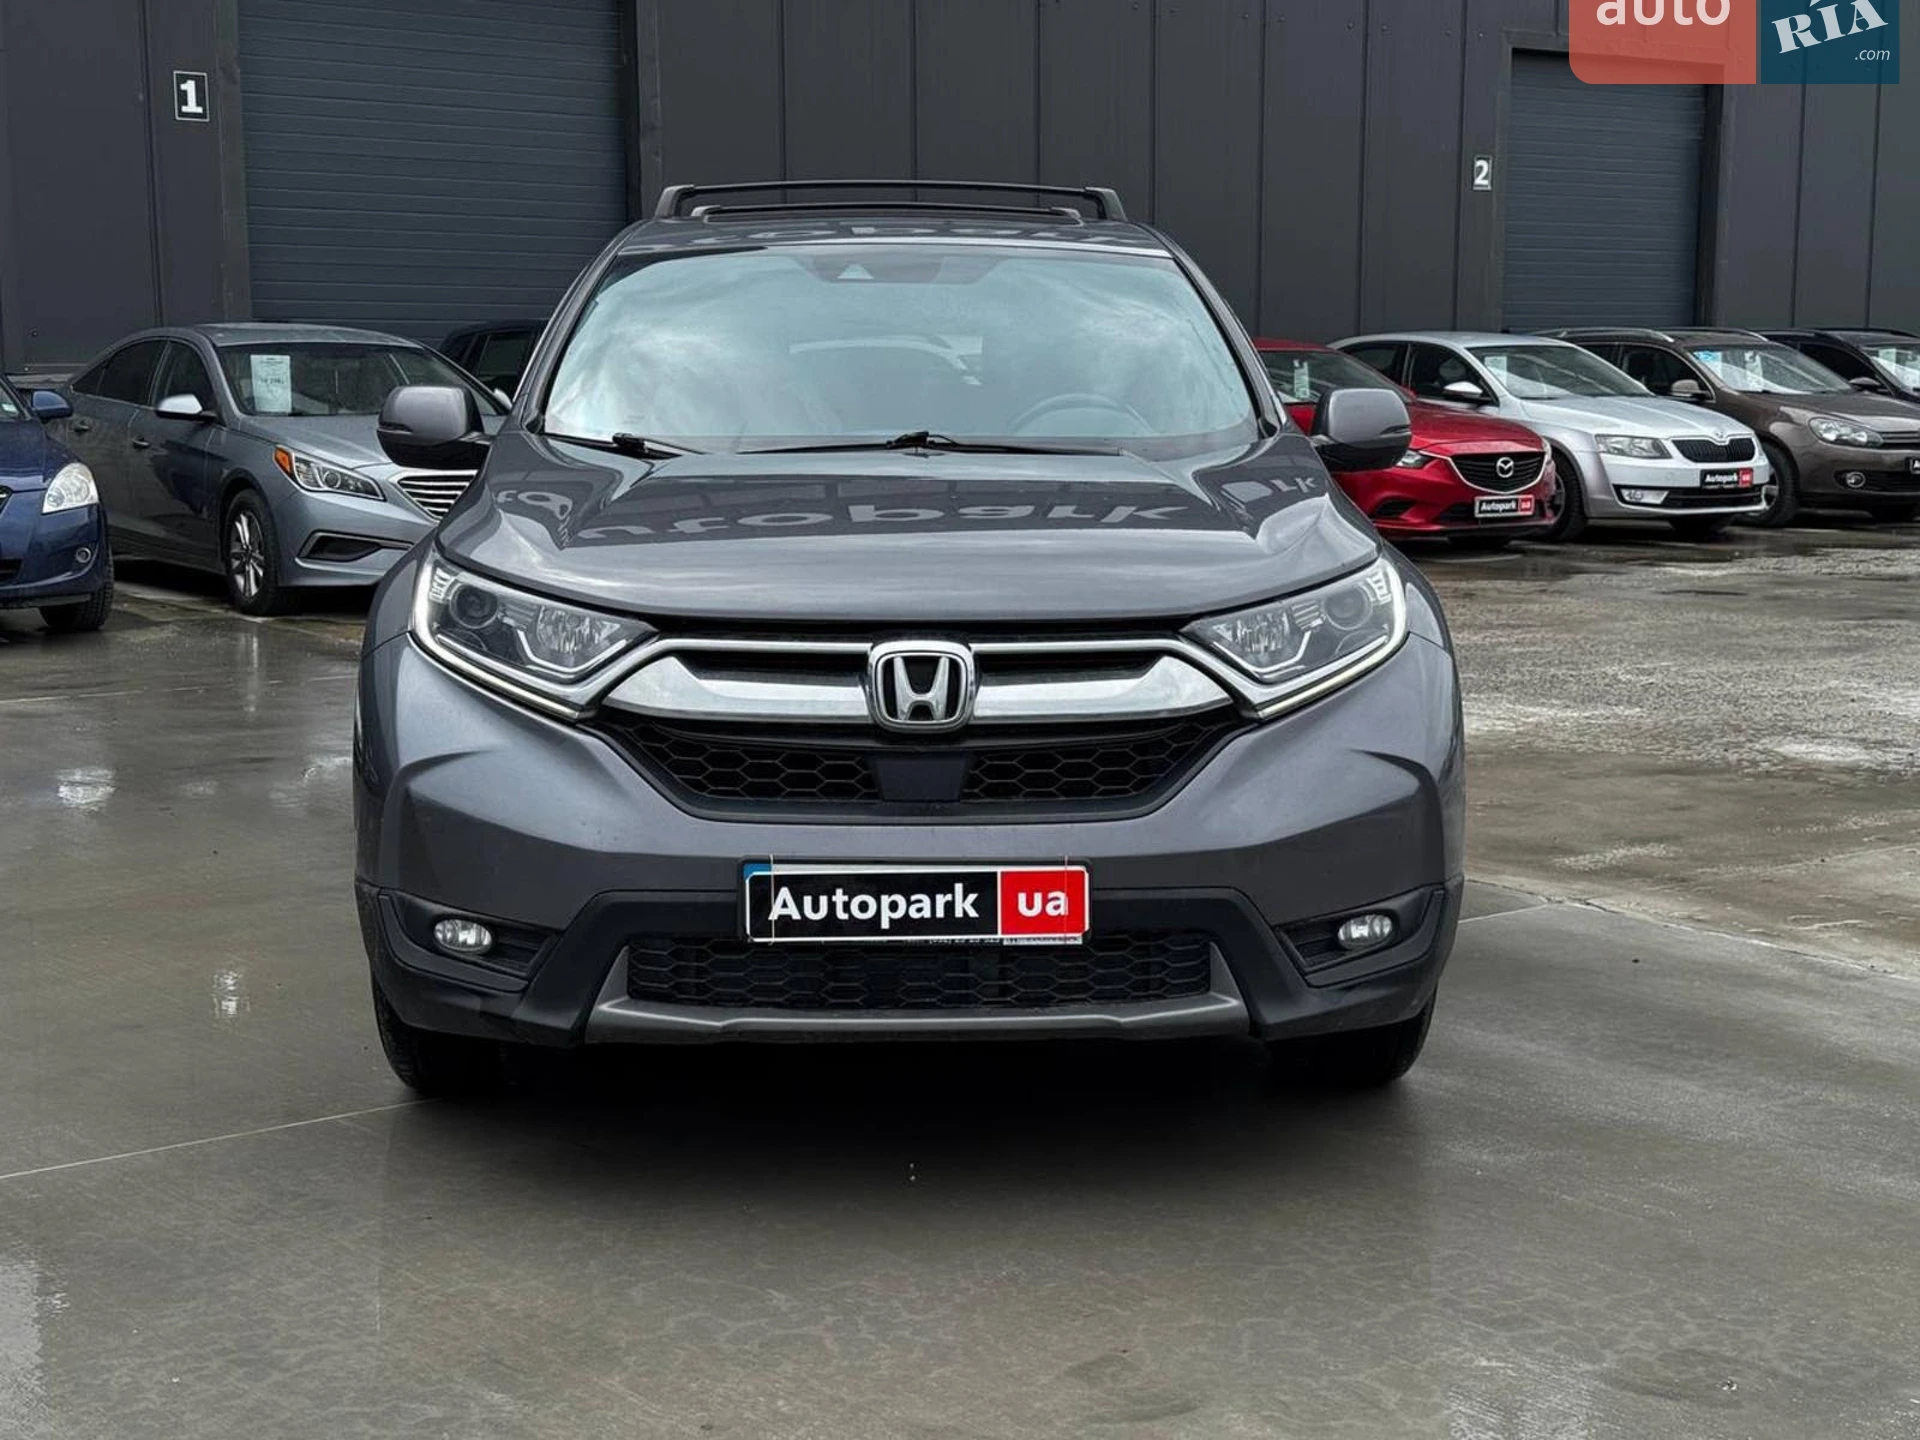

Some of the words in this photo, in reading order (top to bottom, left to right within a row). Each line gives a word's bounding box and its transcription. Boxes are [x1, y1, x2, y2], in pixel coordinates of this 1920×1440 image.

[180, 79, 203, 114] 1
[1474, 159, 1489, 185] 2
[1480, 500, 1516, 512] Autopark
[768, 883, 979, 929] Autopark
[1017, 891, 1068, 916] ua
